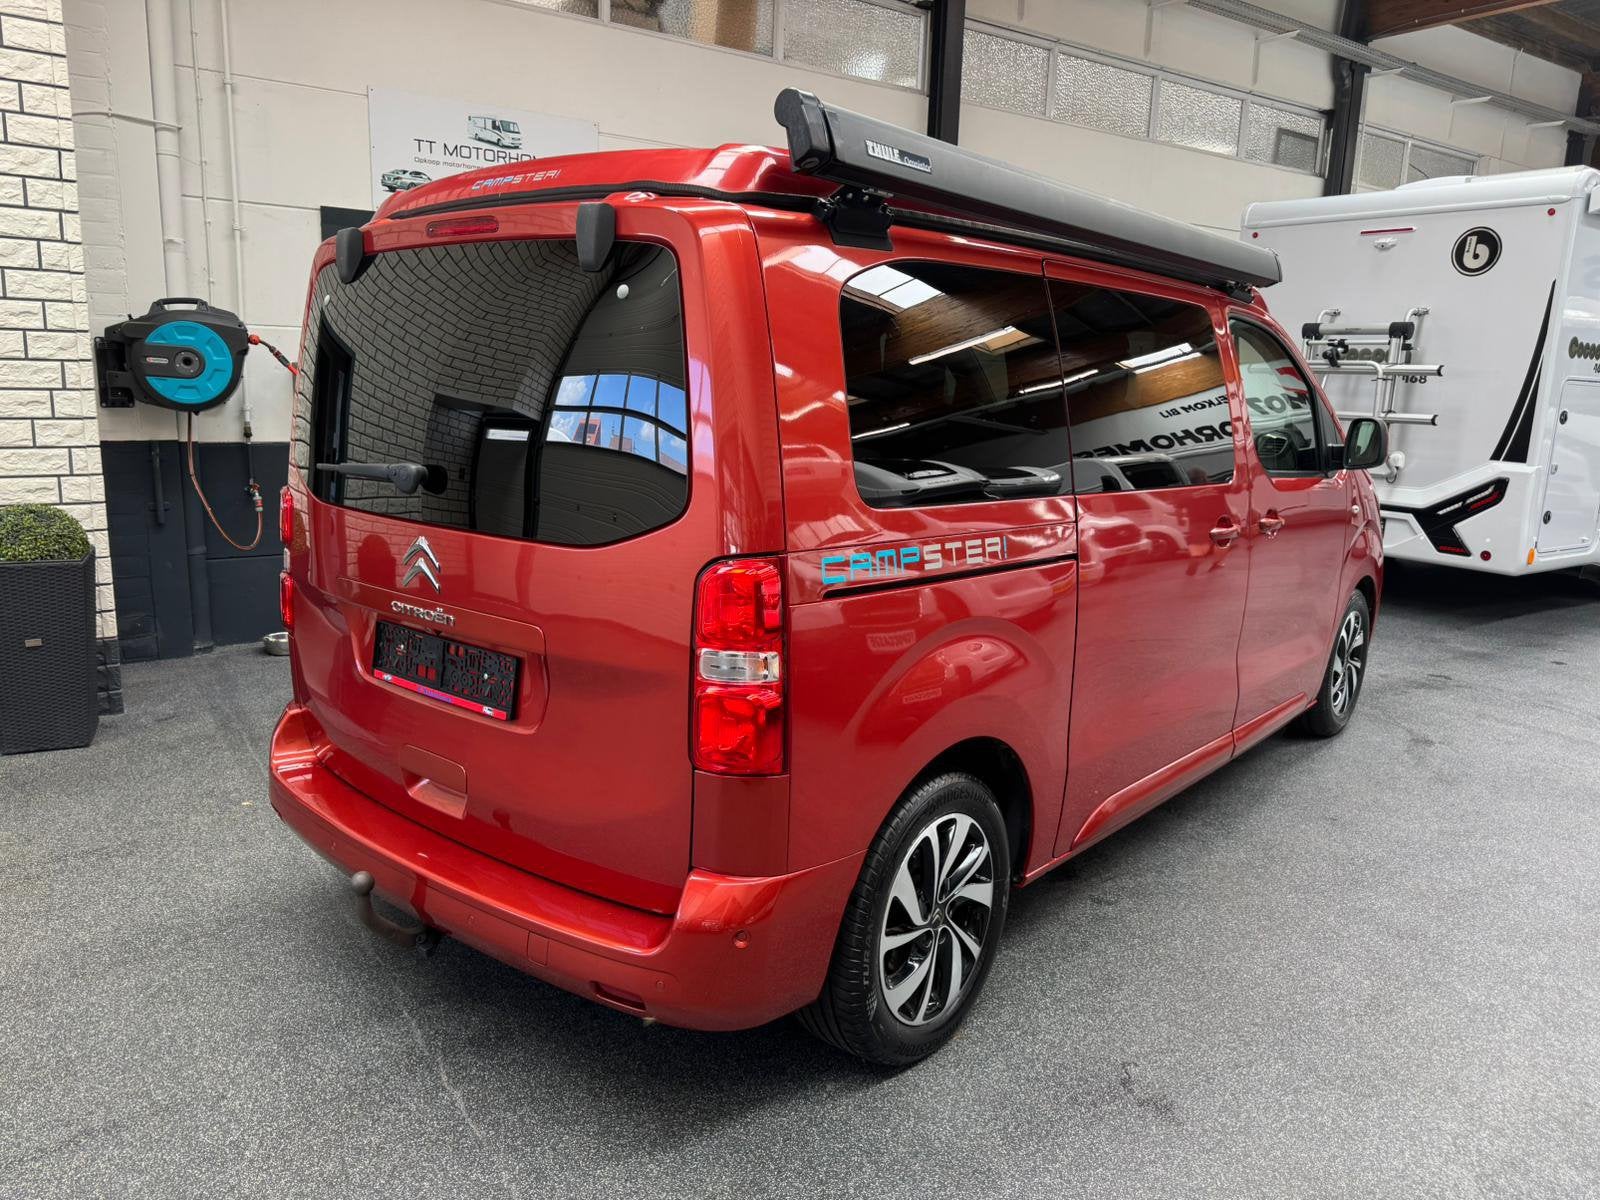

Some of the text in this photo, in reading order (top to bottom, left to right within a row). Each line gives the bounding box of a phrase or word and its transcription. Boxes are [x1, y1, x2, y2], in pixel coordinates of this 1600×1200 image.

[413, 138, 537, 165] TT MOTORHO
[865, 140, 902, 163] THULE
